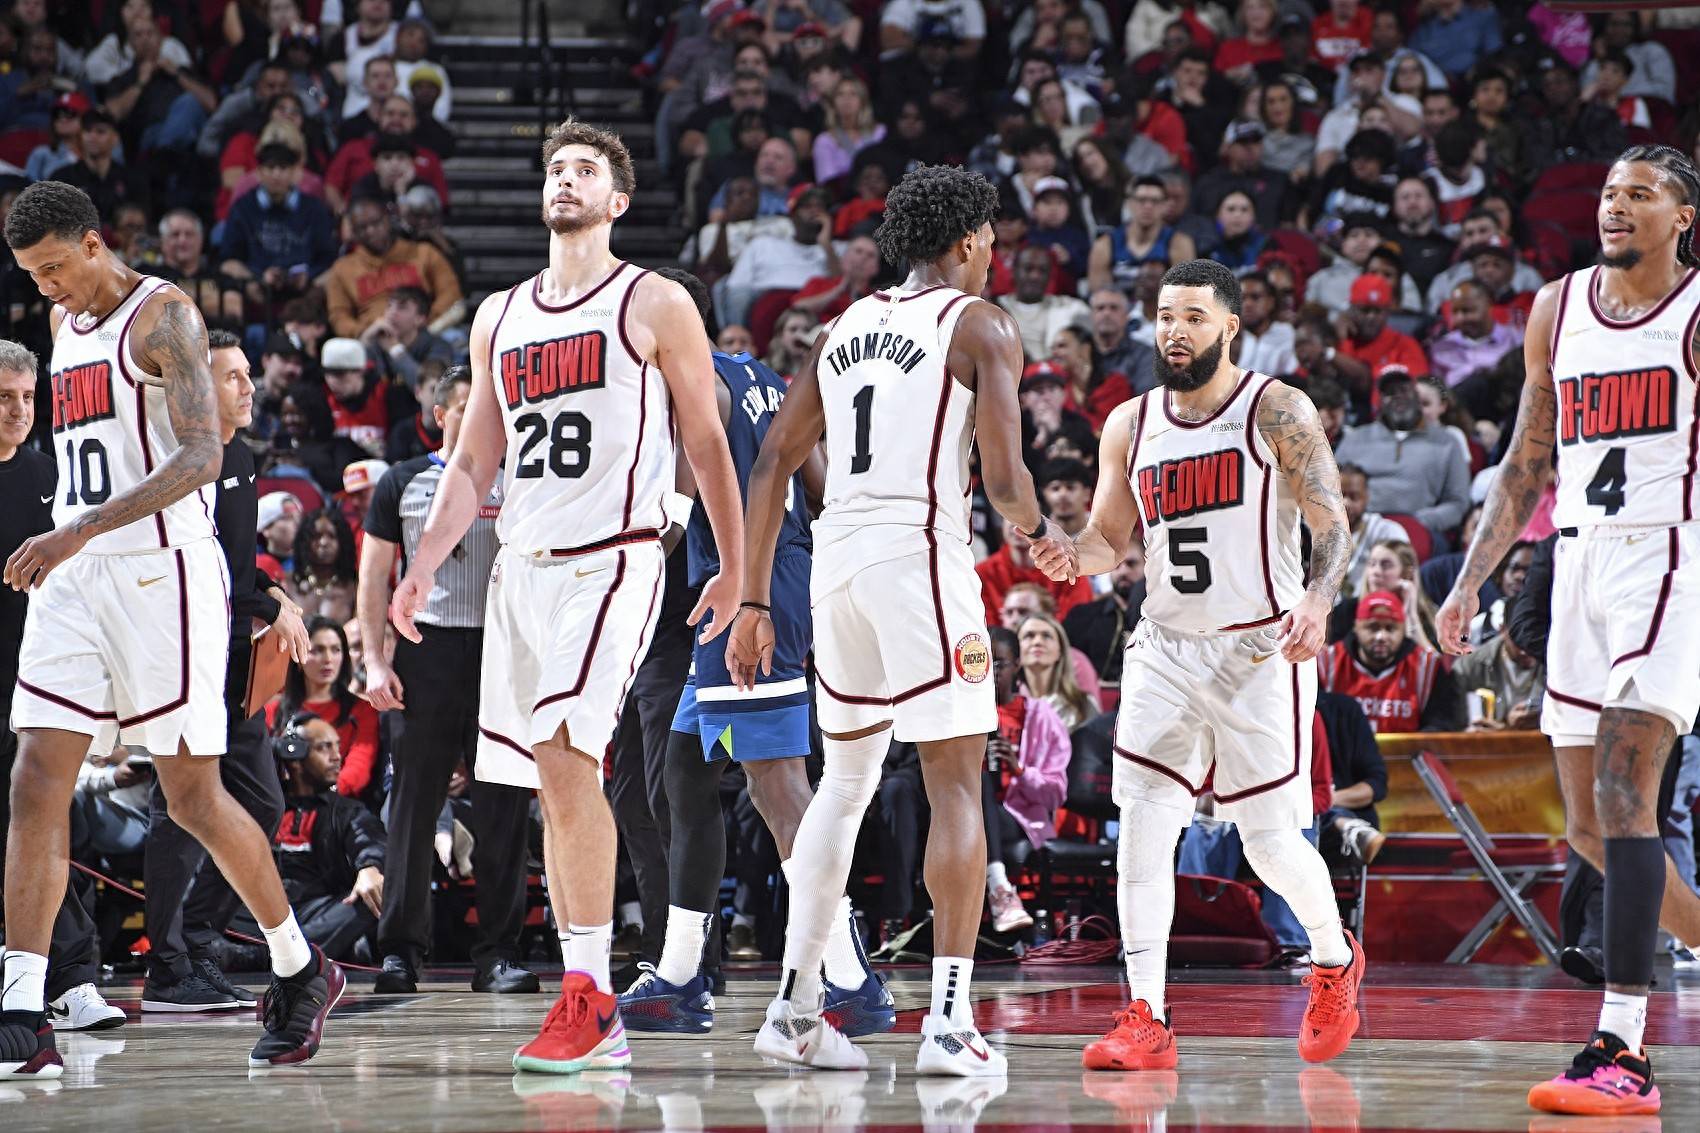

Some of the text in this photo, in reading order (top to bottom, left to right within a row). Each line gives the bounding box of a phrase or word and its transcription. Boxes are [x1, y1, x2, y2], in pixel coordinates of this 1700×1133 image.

[827, 333, 926, 376] THOMPSON
[514, 411, 592, 479] 28
[851, 385, 875, 474] 1
[66, 438, 112, 506] 10
[1586, 447, 1627, 516] 4
[1168, 527, 1212, 595] 5
[1355, 697, 1412, 718] CKETS
